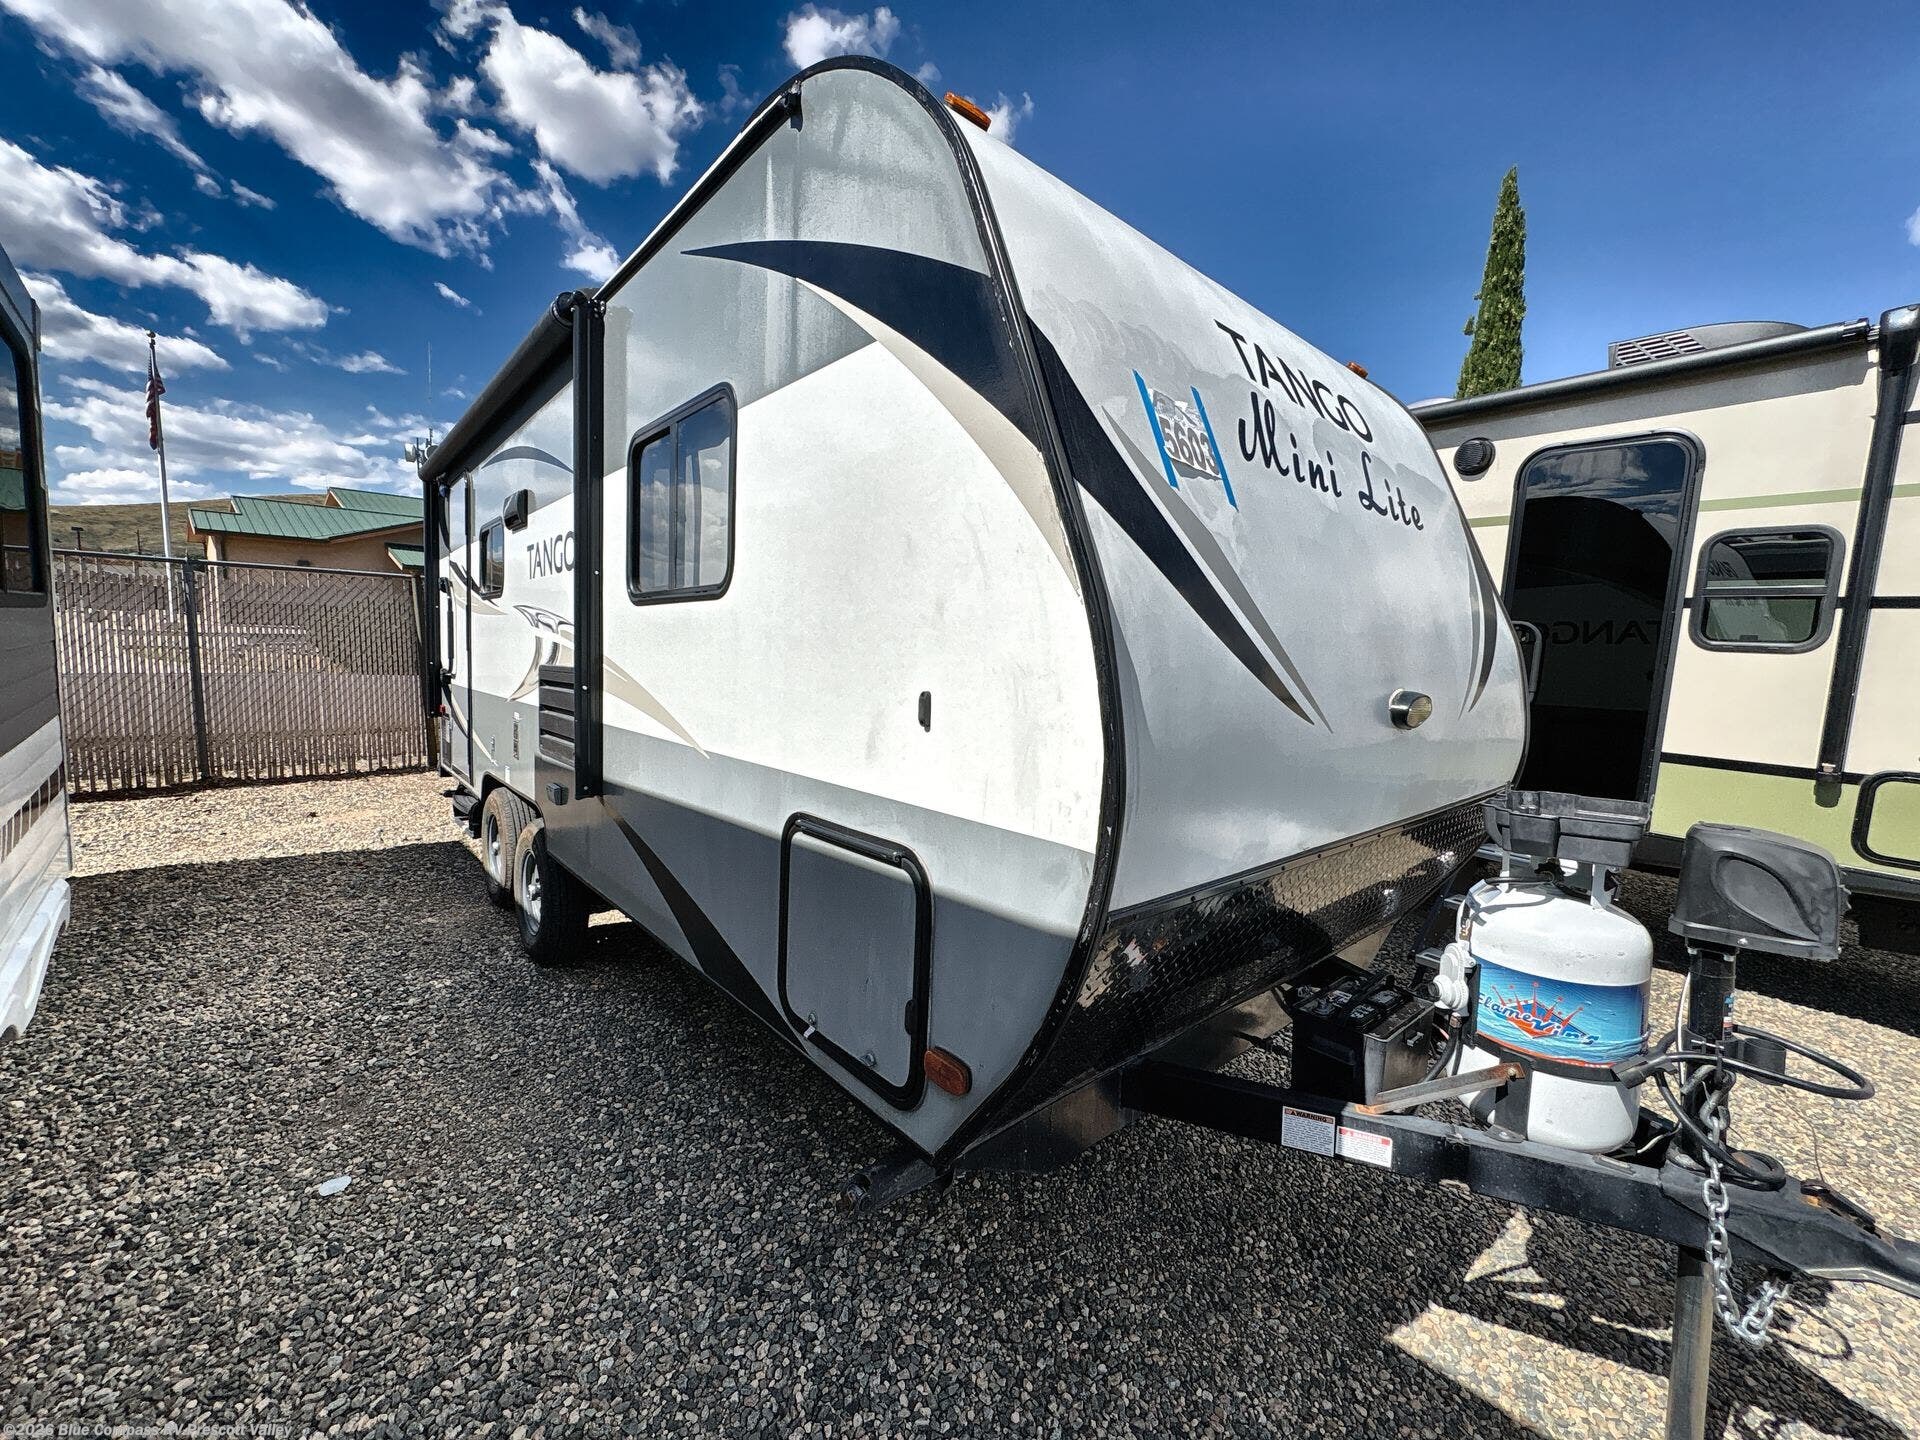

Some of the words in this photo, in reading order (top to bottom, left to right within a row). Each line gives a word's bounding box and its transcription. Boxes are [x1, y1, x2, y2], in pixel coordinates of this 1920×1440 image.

[1213, 319, 1373, 443] TANGO
[1158, 416, 1220, 476] 5603
[1238, 391, 1342, 498] Mini
[1359, 451, 1424, 531] Lite
[526, 530, 574, 579] TANGO
